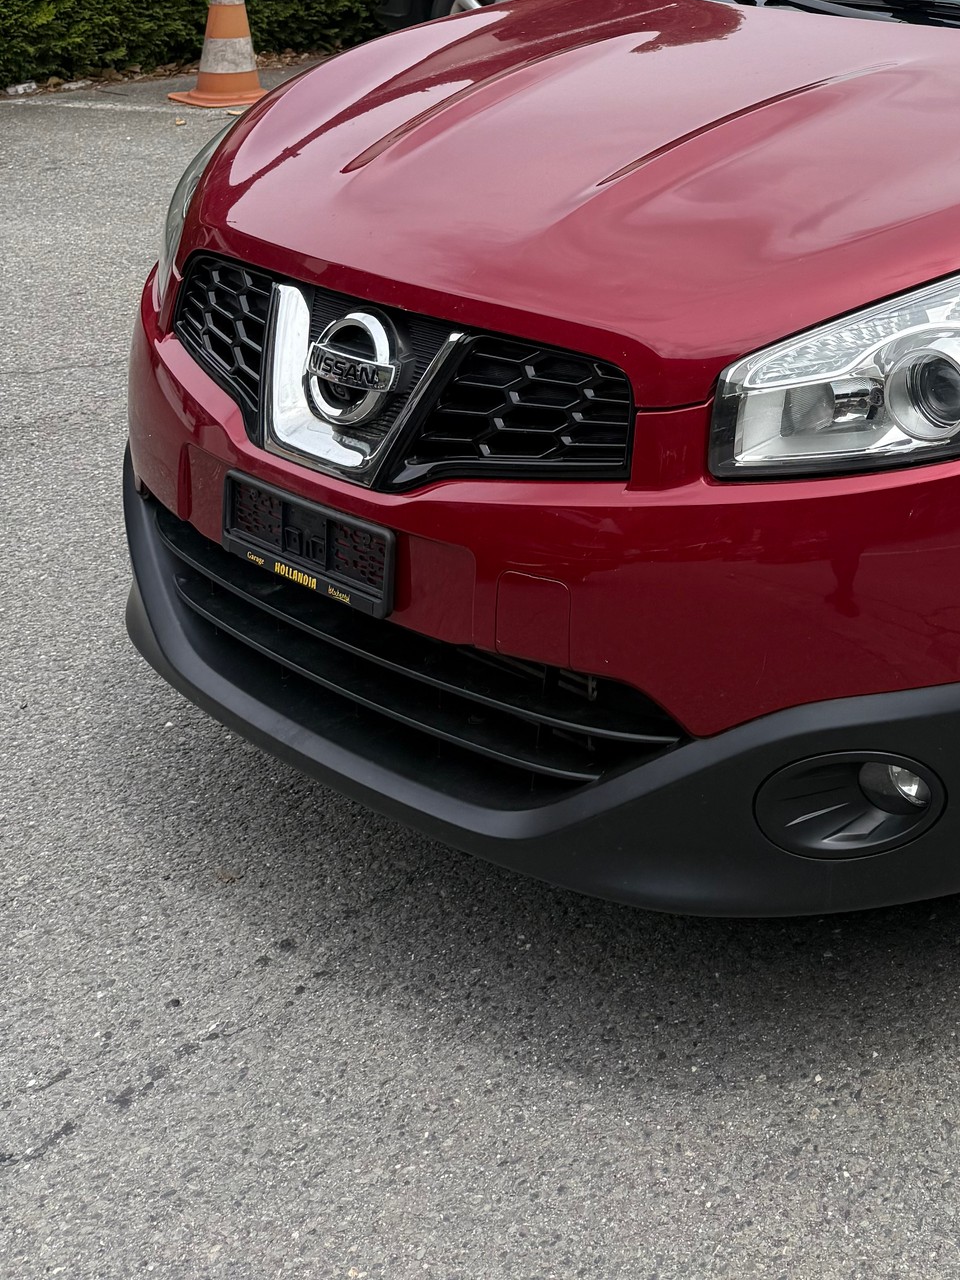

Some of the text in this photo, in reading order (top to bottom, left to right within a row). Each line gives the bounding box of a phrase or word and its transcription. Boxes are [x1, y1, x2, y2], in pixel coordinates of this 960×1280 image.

[308, 348, 379, 386] NISSAN
[246, 551, 265, 566] Garage
[274, 562, 317, 590] HOLLANDIA
